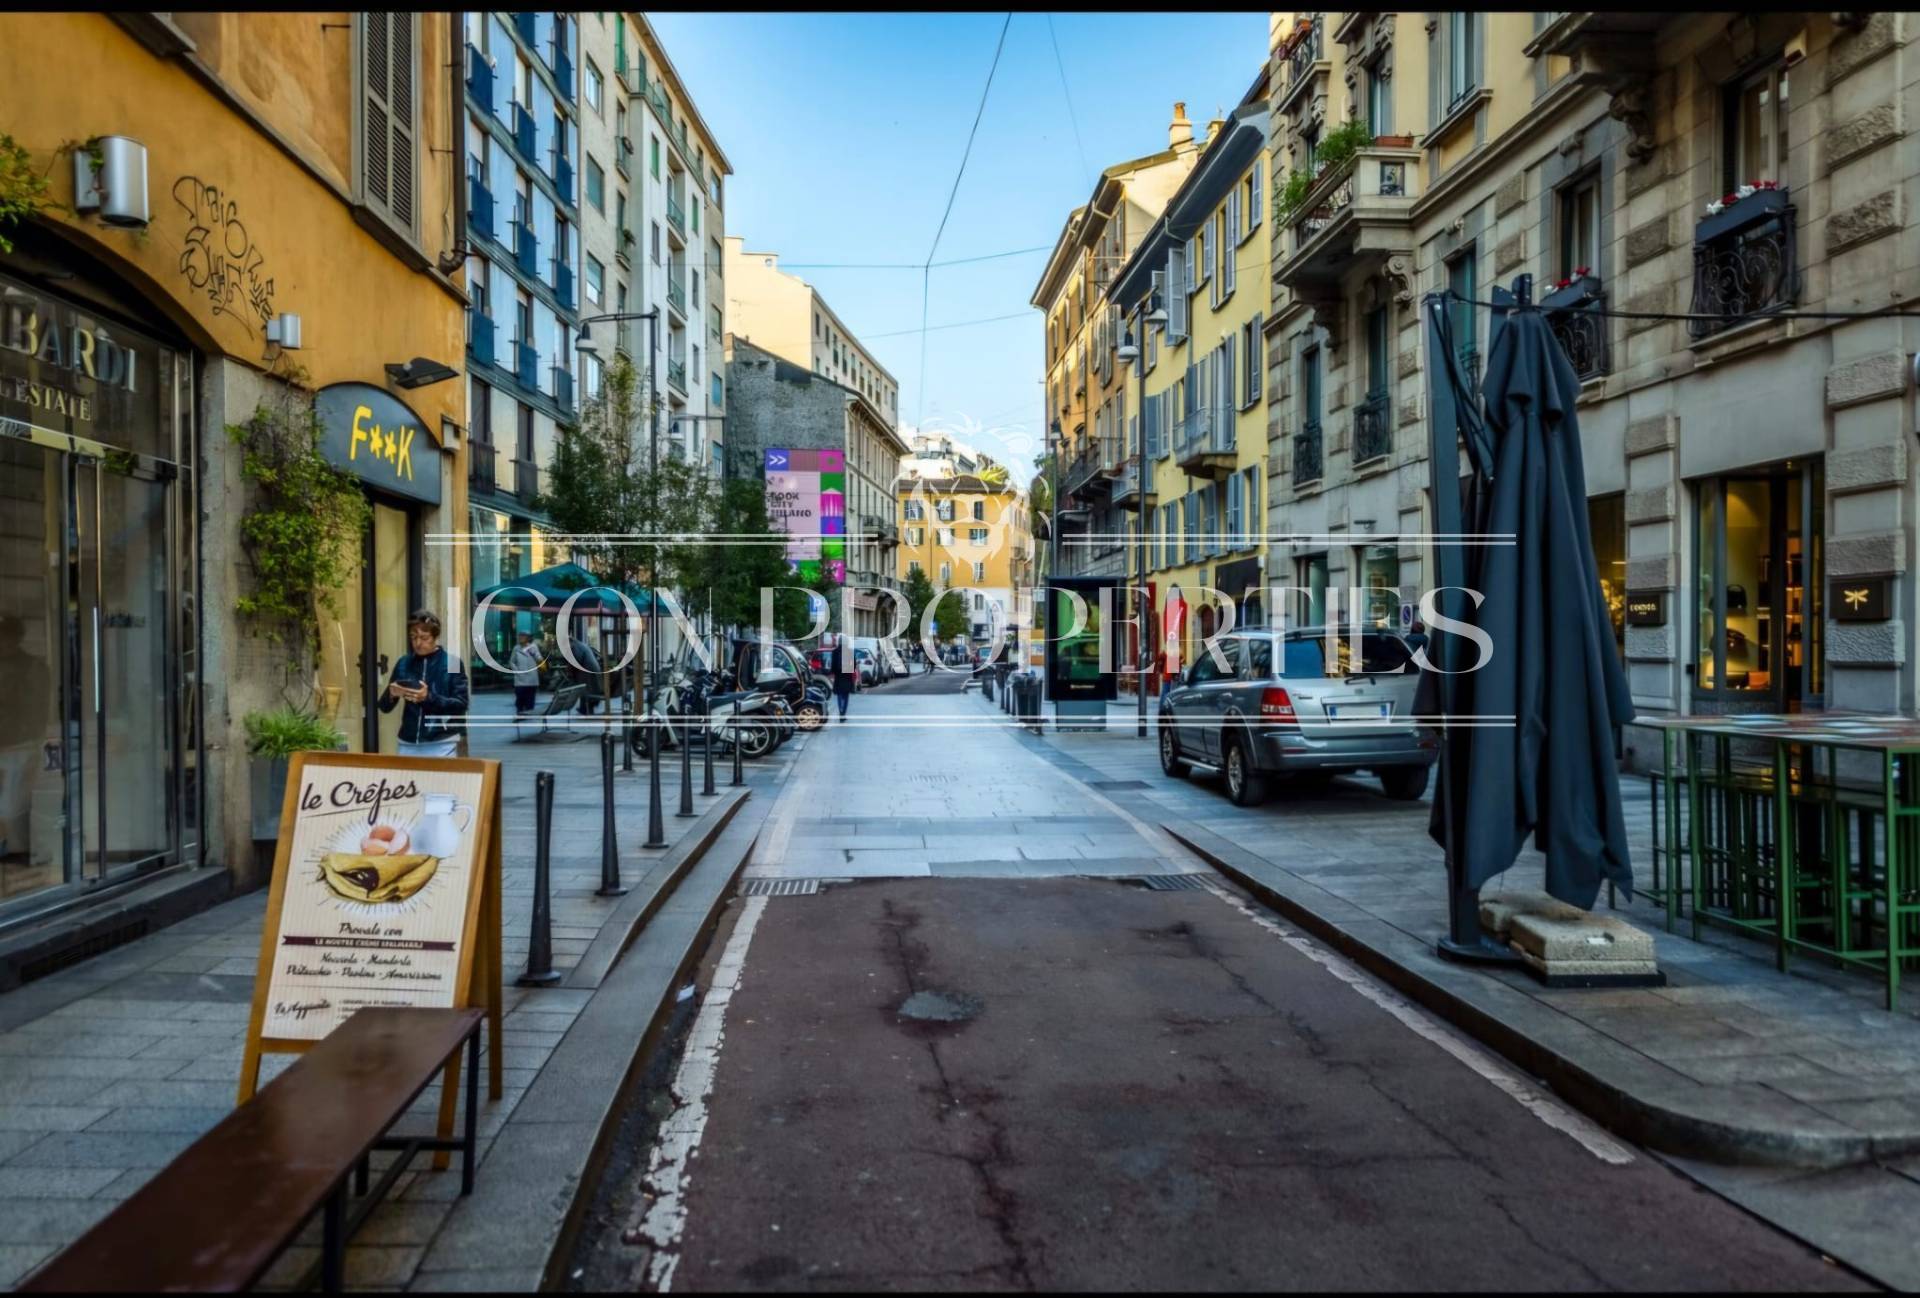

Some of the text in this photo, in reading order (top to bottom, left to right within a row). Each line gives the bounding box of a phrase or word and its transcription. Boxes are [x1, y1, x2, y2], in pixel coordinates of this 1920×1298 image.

[16, 377, 91, 421] ESTATE
[301, 778, 420, 826] le Crêpes
